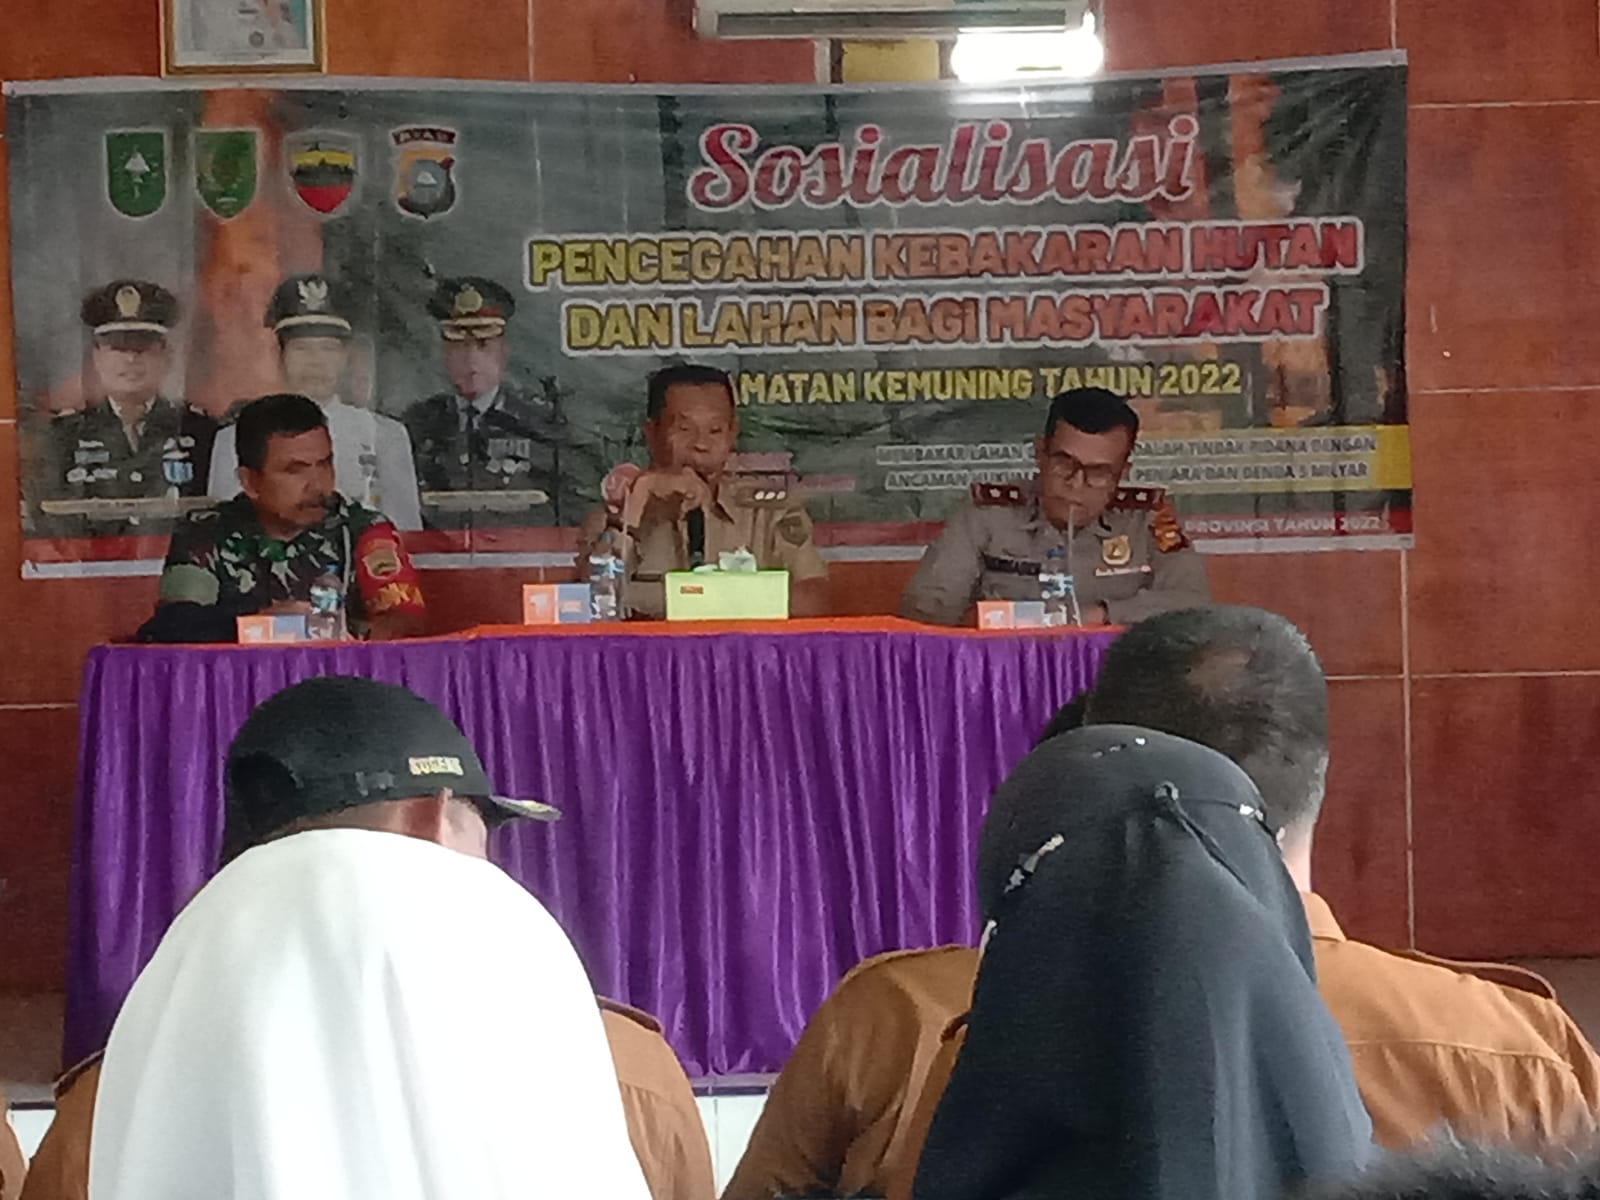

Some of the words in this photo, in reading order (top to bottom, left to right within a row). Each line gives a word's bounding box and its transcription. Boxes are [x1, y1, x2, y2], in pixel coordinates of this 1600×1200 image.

[688, 116, 1198, 212] Sosialisasi
[528, 234, 865, 287] PENCEGAHAN
[872, 226, 1184, 283] KEBAKARAN
[1190, 221, 1359, 273] HUTAN
[566, 302, 673, 349] DAN
[680, 300, 857, 348] LAHAN
[862, 297, 980, 346] BAGI
[986, 288, 1325, 341] MASYARAKAT
[734, 371, 857, 406] MATAN
[863, 367, 1034, 402] KEMUNING
[1159, 361, 1243, 395] 2022
[1310, 433, 1376, 453] DENGAN
[885, 469, 969, 490] ANCAMAN
[1204, 464, 1240, 481] DAN
[1241, 463, 1297, 480] DENDA
[1183, 517, 1270, 534] PROVINSI
[1274, 516, 1336, 533] TAHUN
